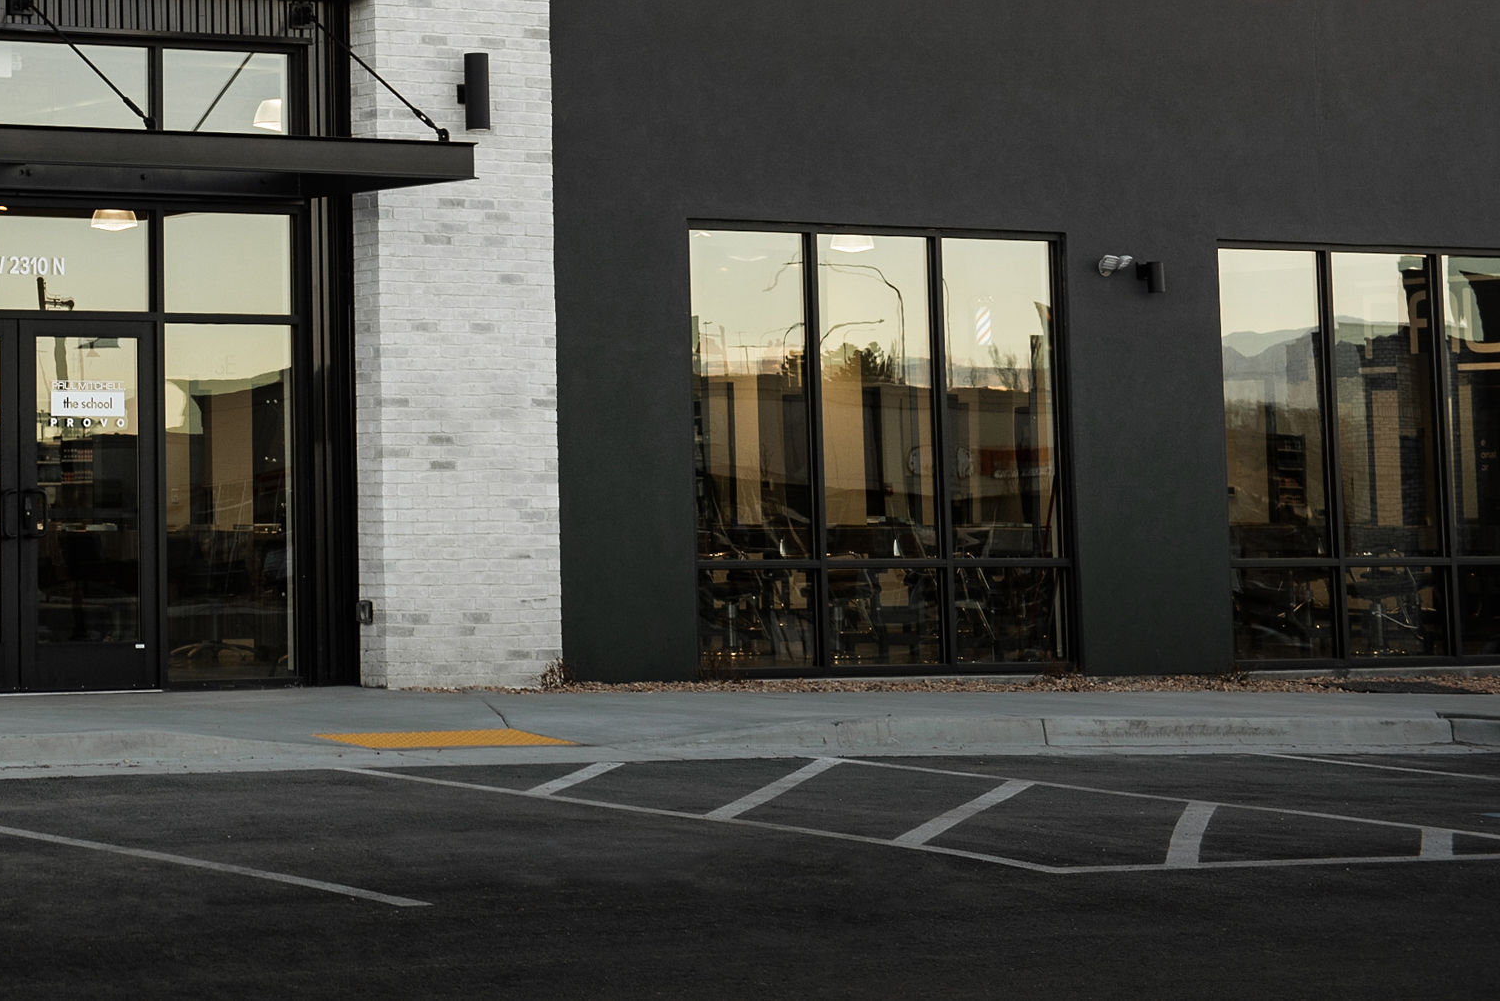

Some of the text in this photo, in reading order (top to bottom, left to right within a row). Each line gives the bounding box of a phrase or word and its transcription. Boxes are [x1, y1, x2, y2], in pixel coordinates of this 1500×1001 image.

[9, 256, 48, 275] 2310
[52, 257, 65, 275] N
[52, 381, 122, 391] PAUL MITCHELL
[63, 396, 113, 409] the school
[50, 418, 125, 428] PROVO
